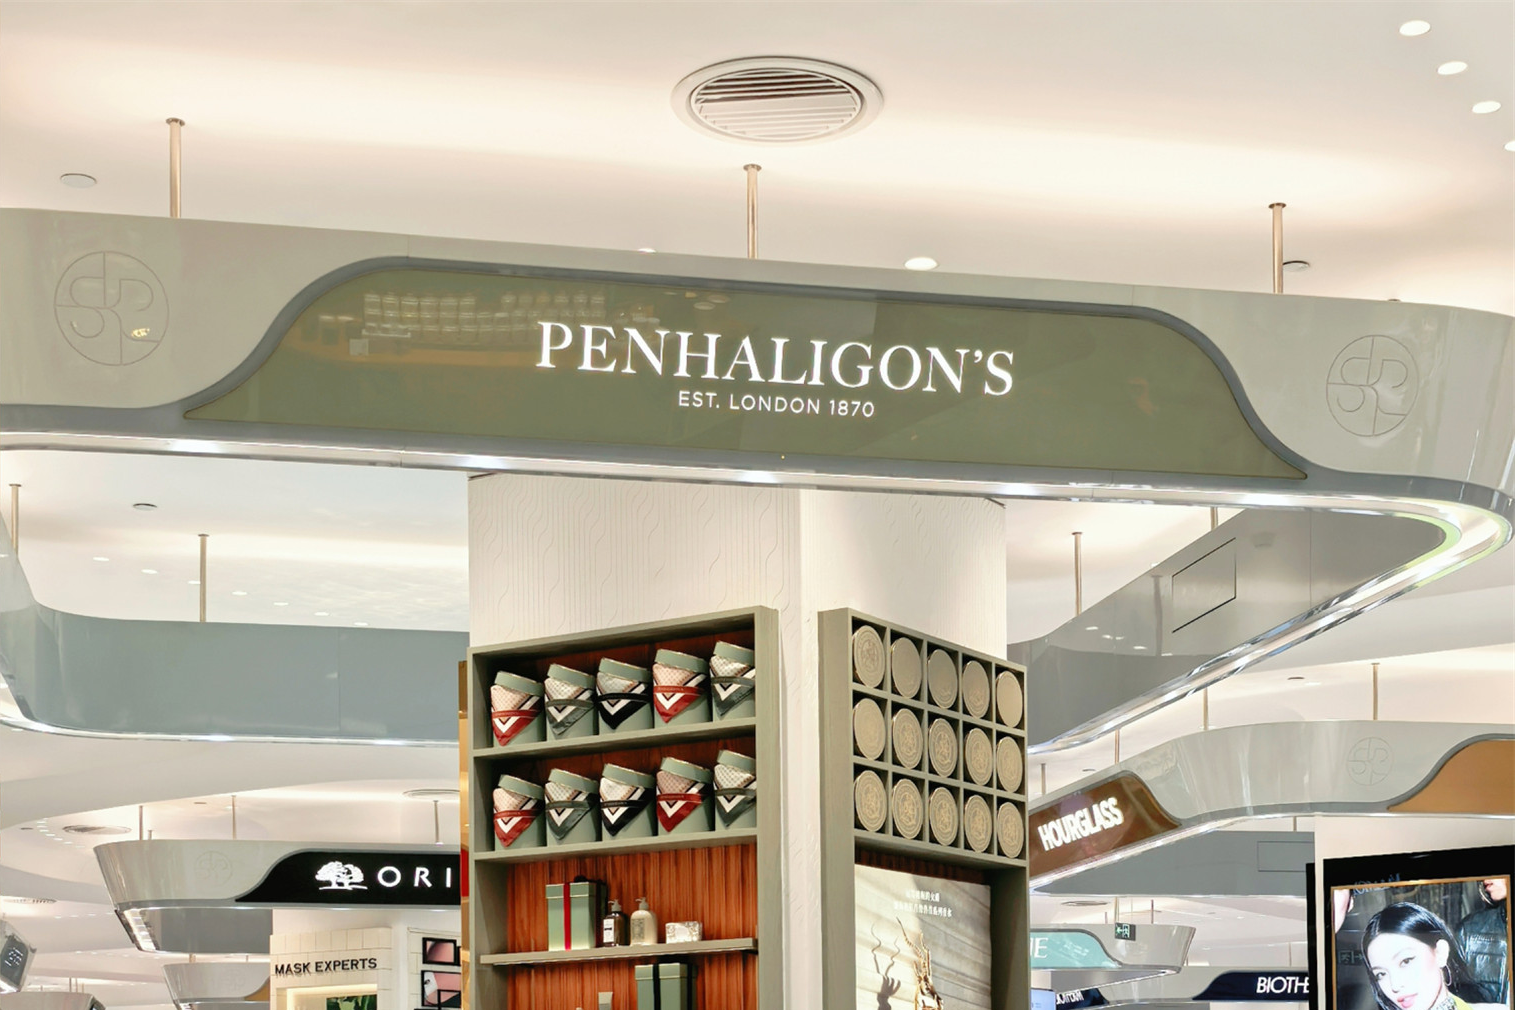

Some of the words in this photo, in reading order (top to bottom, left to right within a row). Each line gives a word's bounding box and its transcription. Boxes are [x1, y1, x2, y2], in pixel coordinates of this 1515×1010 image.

[535, 321, 1014, 396] PENHALIGON'S
[678, 390, 720, 409] EST.
[729, 393, 820, 415] LONDON
[829, 400, 875, 418] 1870
[1037, 797, 1124, 851] HOURGLASS
[377, 866, 452, 888] ORI
[274, 962, 311, 976] MASK
[314, 957, 378, 973] EXPERTS
